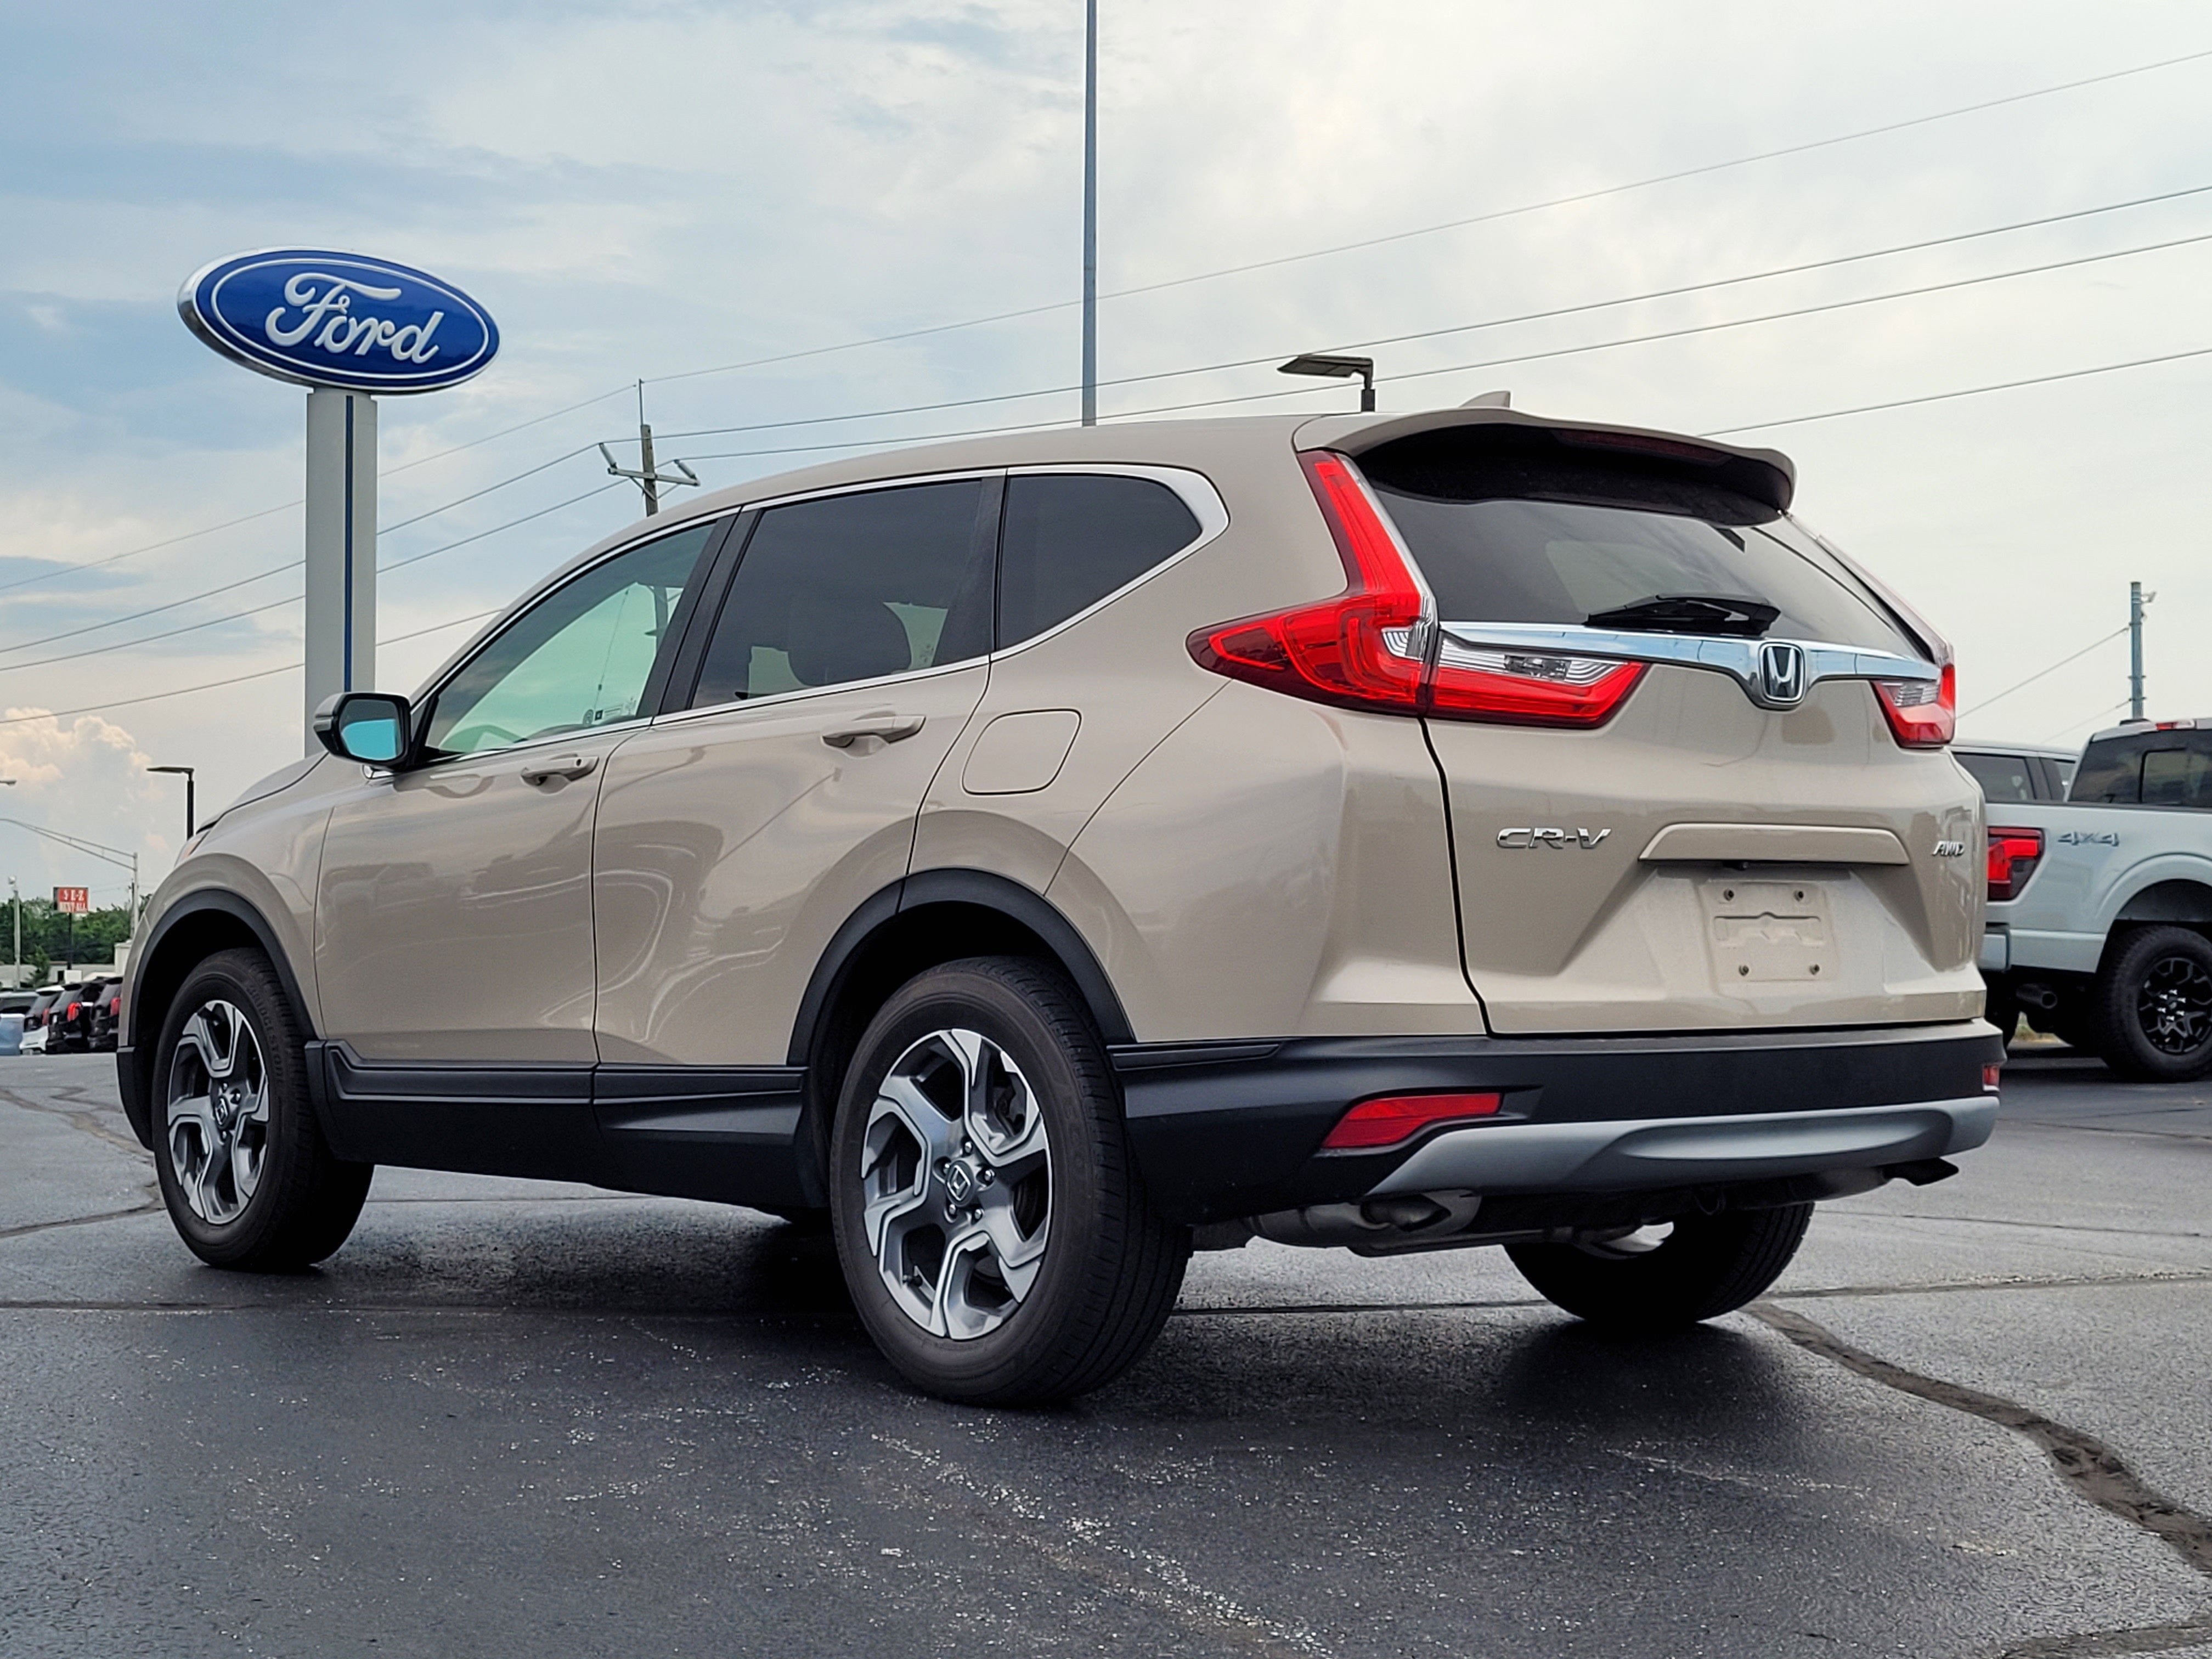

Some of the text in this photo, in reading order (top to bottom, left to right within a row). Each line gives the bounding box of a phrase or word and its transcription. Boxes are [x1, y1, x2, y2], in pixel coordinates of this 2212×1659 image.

[265, 273, 444, 364] Ford
[1497, 827, 1612, 849] CR-V
[1932, 840, 1965, 856] AWD
